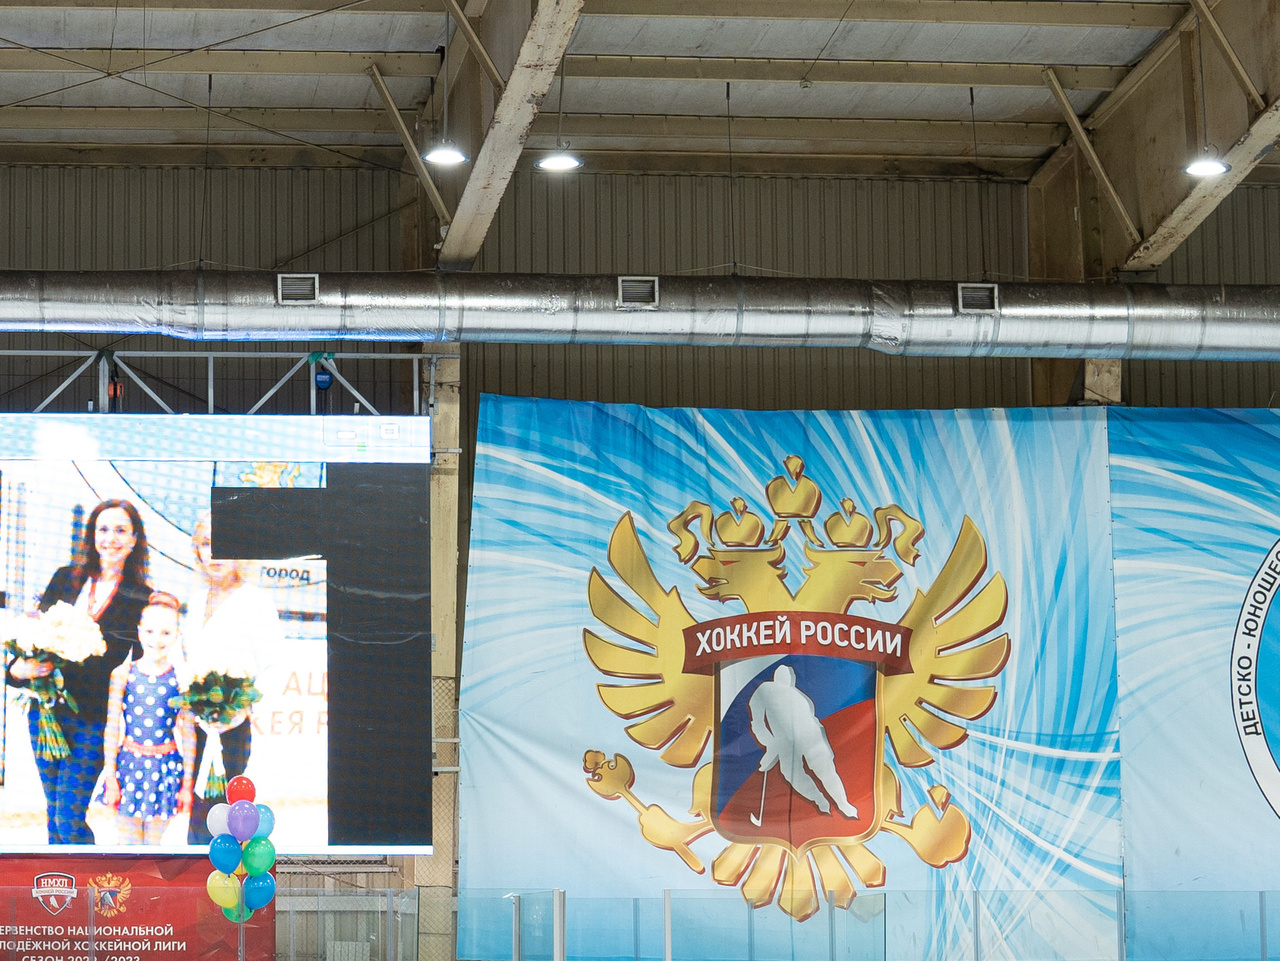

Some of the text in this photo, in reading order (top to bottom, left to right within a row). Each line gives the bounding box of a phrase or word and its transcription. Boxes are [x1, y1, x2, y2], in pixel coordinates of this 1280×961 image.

[695, 615, 902, 658] ХОККЕЙ РОССИИ
[1237, 655, 1261, 737] ДЕТСКО
[41, 879, 68, 888] НМХЛ
[68, 923, 174, 936] НАЦИОНАЛЬНОЙ
[73, 938, 151, 951] ХОККЕЙНОЙ
[153, 941, 186, 951] ЛИГИ
